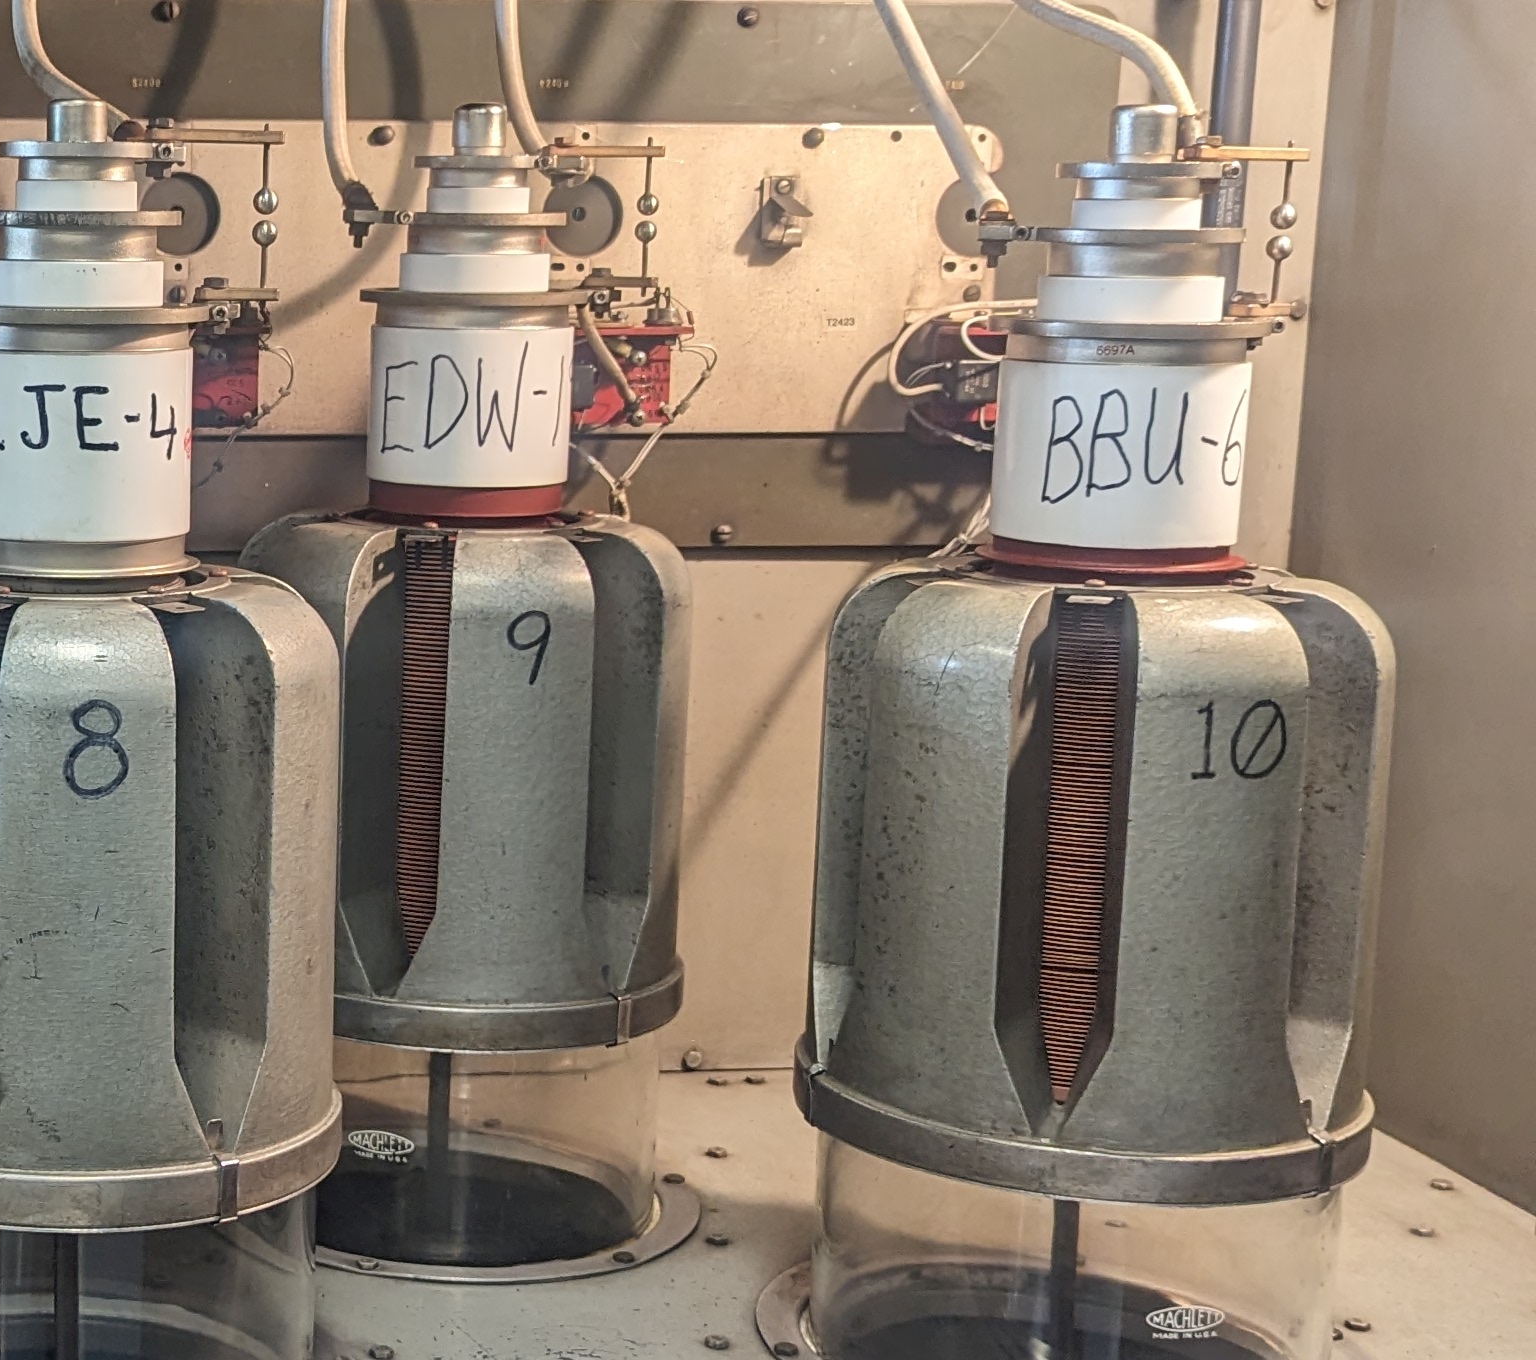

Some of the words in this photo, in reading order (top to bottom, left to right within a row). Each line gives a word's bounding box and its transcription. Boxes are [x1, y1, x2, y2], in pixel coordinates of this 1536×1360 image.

[826, 317, 855, 327] T2423
[1096, 344, 1135, 357] 6697A
[1041, 387, 1247, 505] BBU-6
[506, 610, 552, 685] 9
[62, 699, 130, 798] 8
[1190, 699, 1287, 780] 10
[1152, 1307, 1220, 1329] MACHLETT
